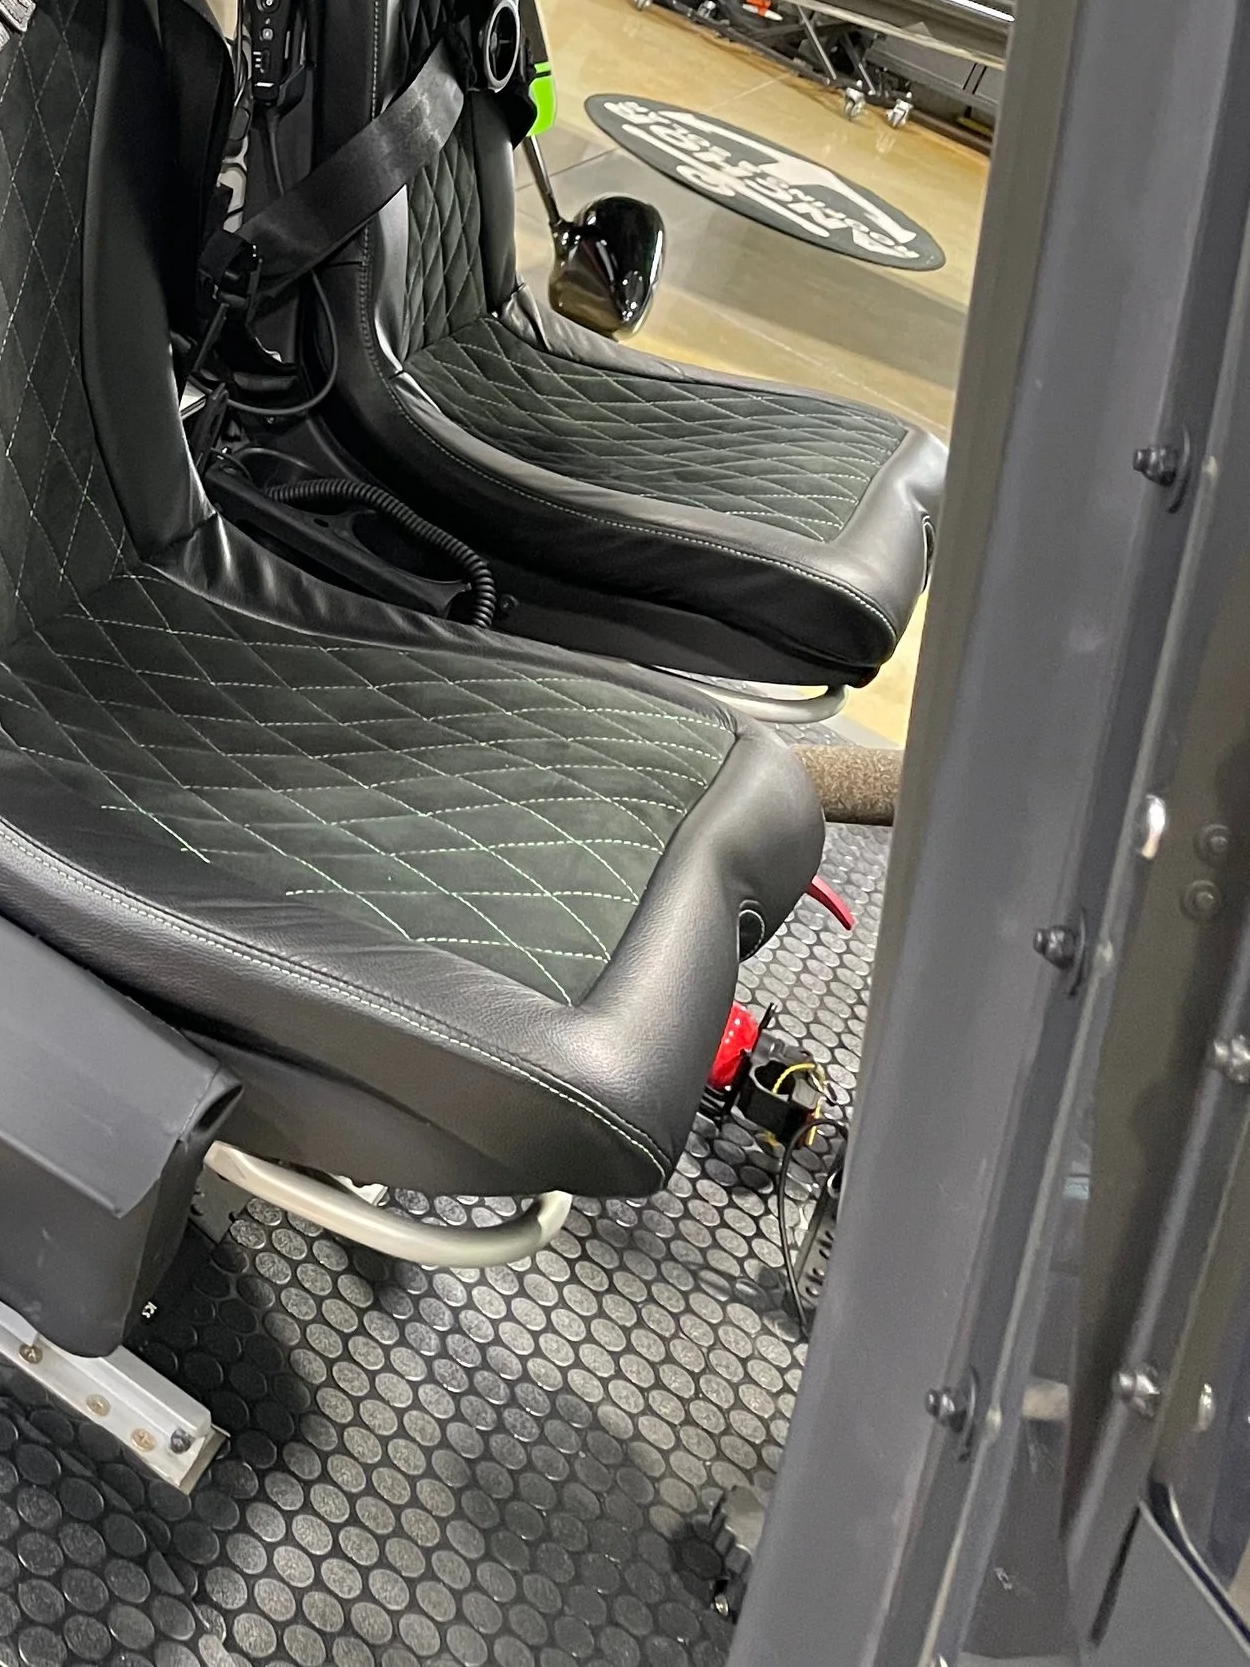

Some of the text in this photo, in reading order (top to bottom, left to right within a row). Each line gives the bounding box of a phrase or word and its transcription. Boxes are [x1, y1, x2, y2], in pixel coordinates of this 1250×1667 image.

[619, 100, 731, 157] SOLAR
[604, 102, 909, 257] ANCHOR
[764, 174, 919, 257] ROOFING
